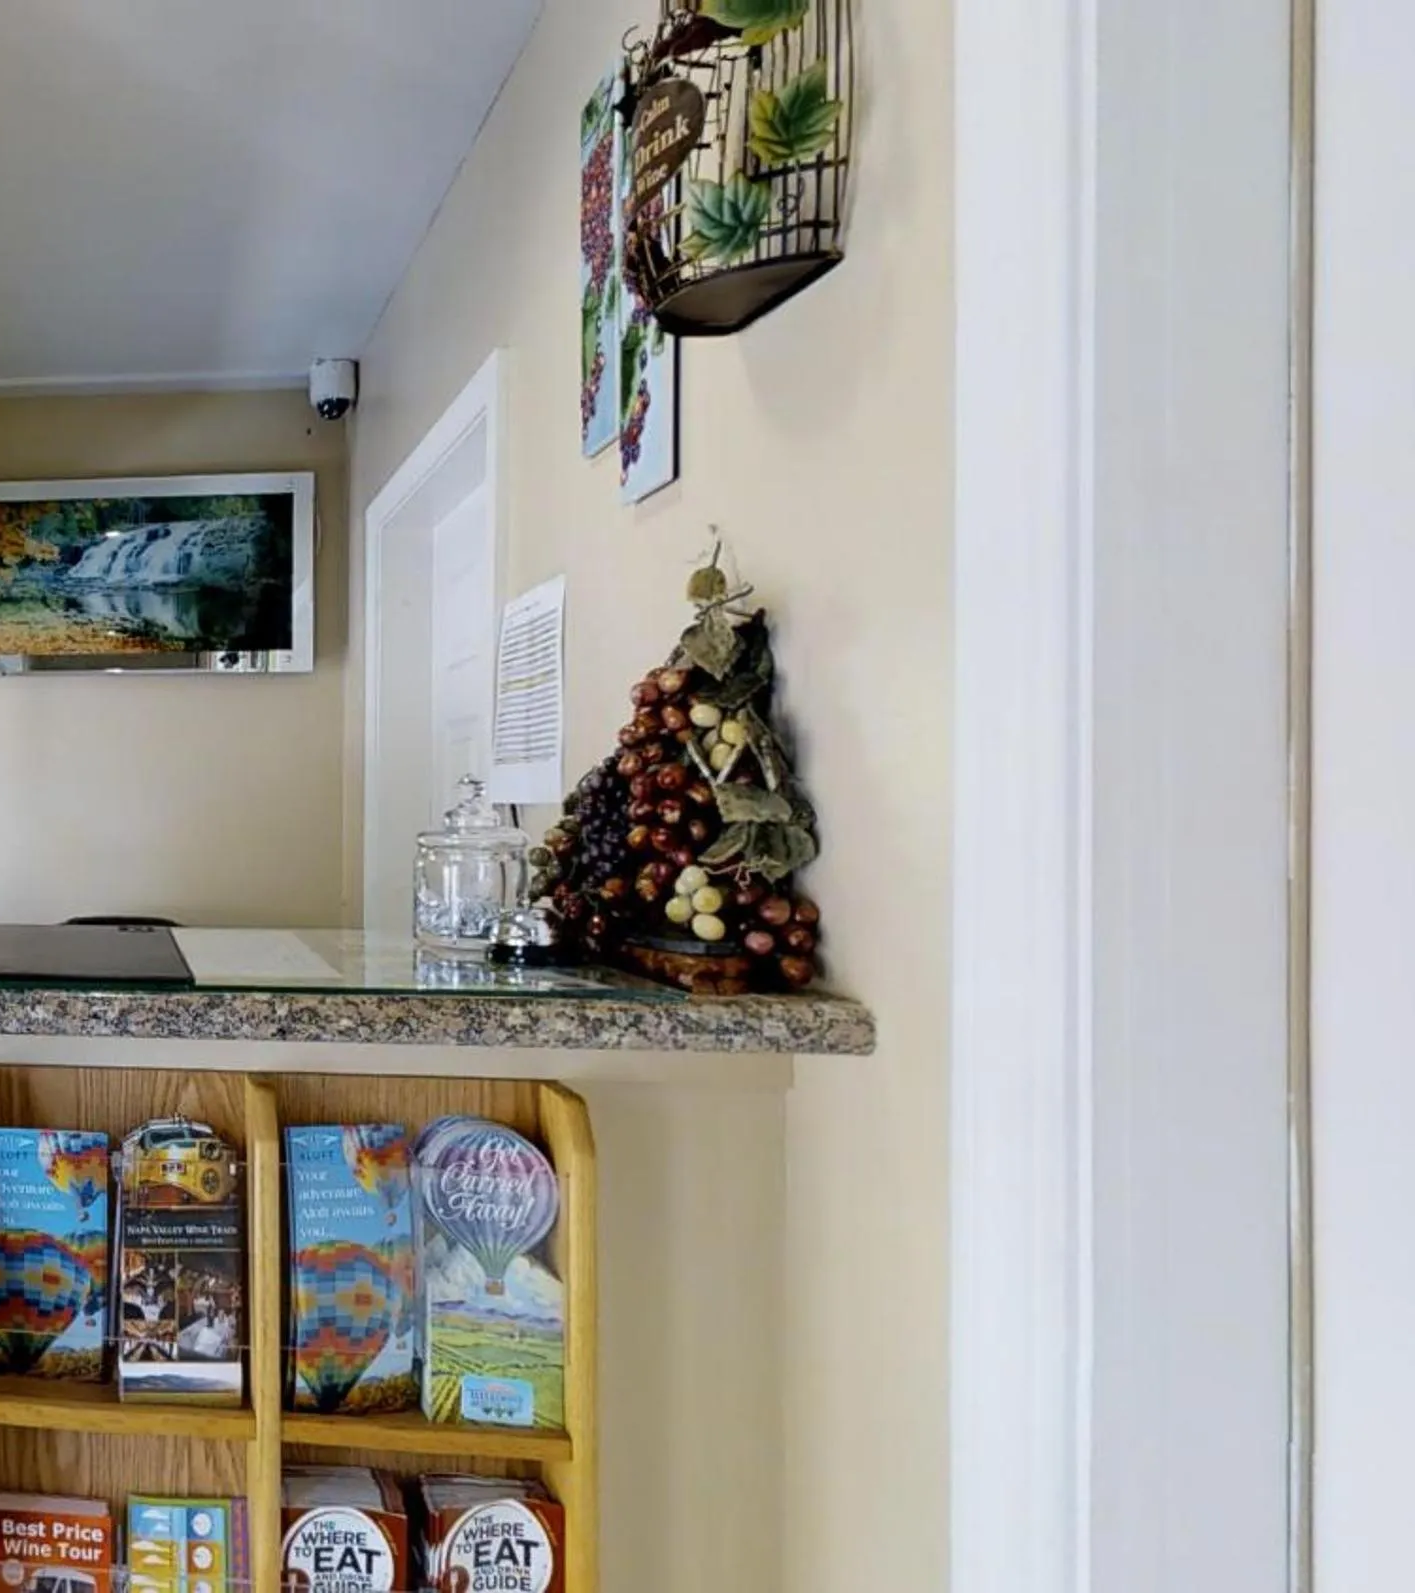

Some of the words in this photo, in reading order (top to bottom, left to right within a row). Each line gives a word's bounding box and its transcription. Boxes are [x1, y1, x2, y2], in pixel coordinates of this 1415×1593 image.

[297, 1170, 328, 1181] Your
[438, 1192, 535, 1231] Away!
[152, 1224, 184, 1236] VALLEY
[313, 1521, 336, 1531] THE
[474, 1514, 495, 1526] THE
[1, 1518, 46, 1538] Best
[52, 1521, 104, 1543] Price
[301, 1531, 367, 1546] WHERE
[463, 1522, 525, 1541] WHERE
[3, 1538, 53, 1558] Wine
[57, 1541, 103, 1562] Tour
[456, 1543, 472, 1555] TO
[473, 1538, 539, 1569] EAT
[294, 1546, 313, 1558] TO
[313, 1546, 382, 1575] EAT
[313, 1581, 373, 1593] GUIDE
[472, 1575, 532, 1593] GUIDE
